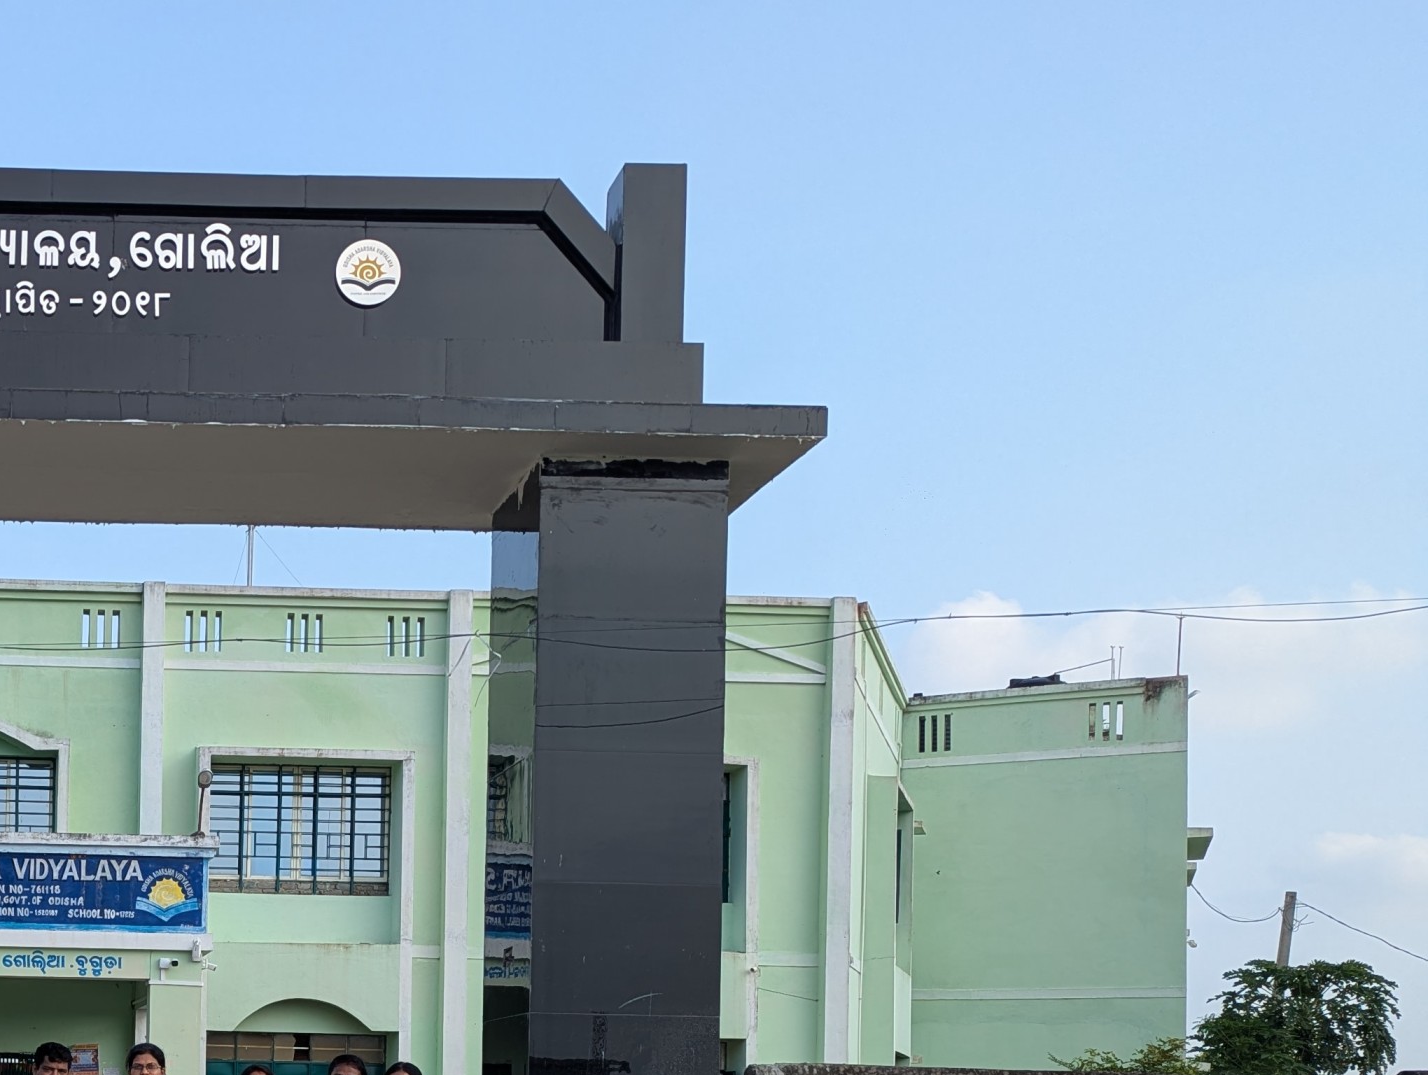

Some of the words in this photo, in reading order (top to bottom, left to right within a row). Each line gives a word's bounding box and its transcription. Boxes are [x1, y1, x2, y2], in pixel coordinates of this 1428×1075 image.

[129, 222, 280, 271] ଗୋଲିଆ
[12, 858, 144, 882] VIDYALAYA
[47, 896, 85, 907] ODISHA
[67, 908, 103, 919] SCHOOL
